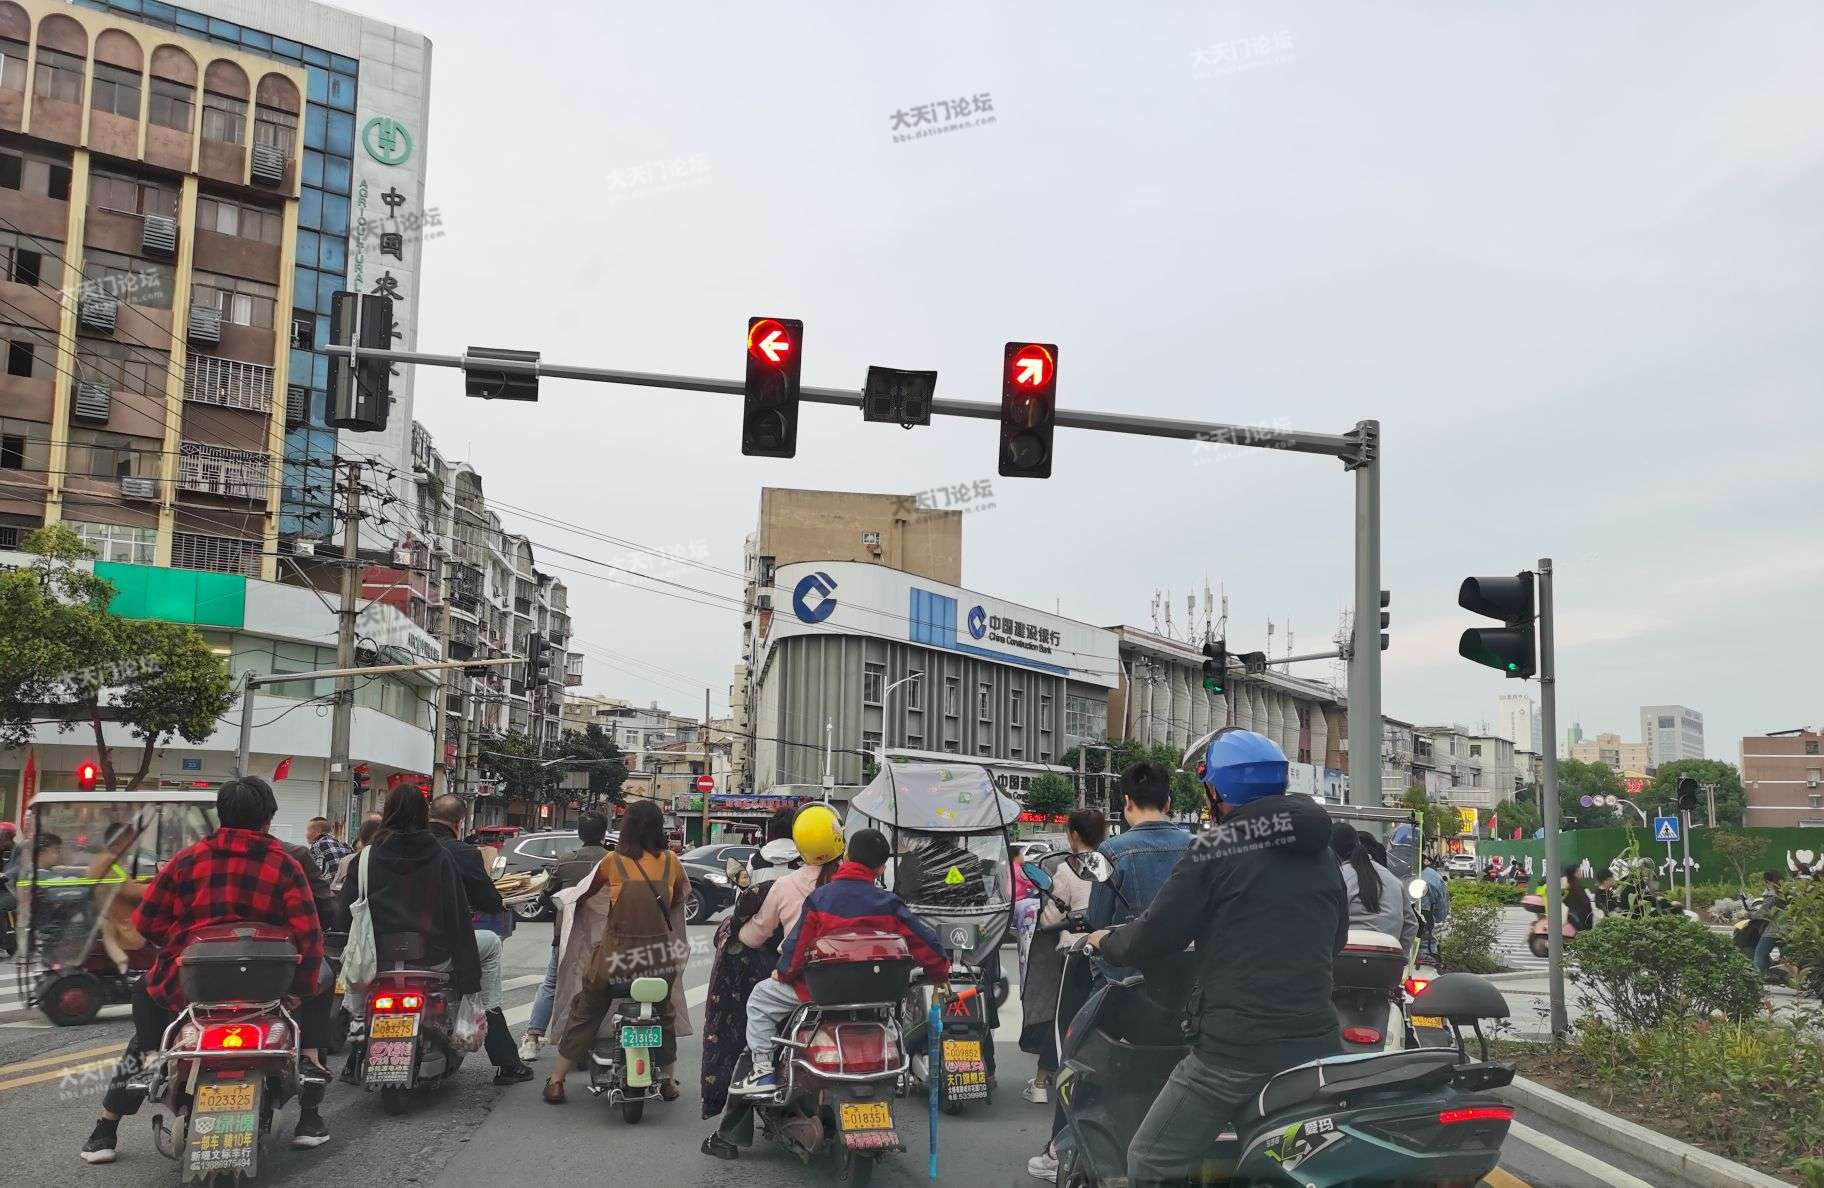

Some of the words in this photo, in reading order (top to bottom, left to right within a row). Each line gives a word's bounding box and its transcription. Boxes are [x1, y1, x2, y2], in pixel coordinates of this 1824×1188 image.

[989, 615, 1060, 646] 中国建设银行
[988, 632, 1006, 643] China
[1006, 636, 1038, 651] Construction
[1038, 644, 1052, 654] Bank
[630, 1034, 658, 1044] 213152
[208, 1094, 250, 1106] 023325
[851, 1112, 886, 1124] 018351
[1304, 1118, 1334, 1136] 爱玛
